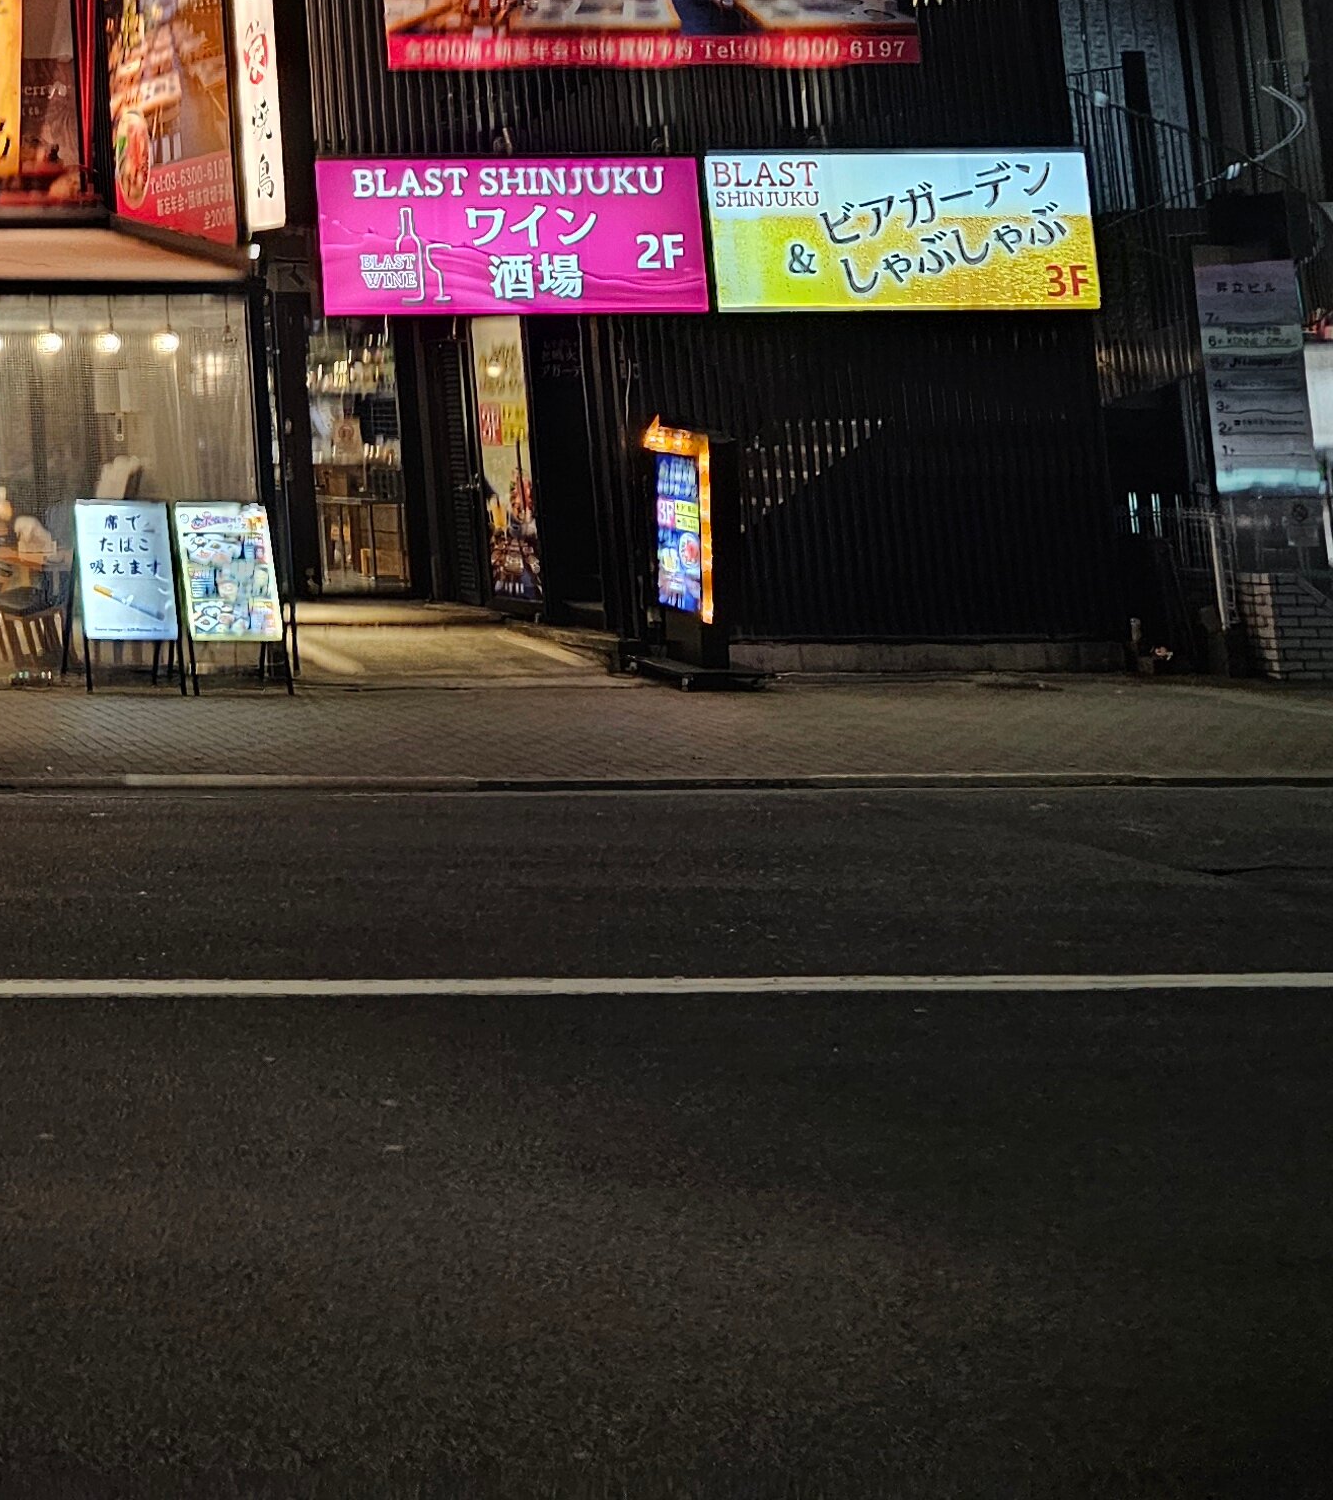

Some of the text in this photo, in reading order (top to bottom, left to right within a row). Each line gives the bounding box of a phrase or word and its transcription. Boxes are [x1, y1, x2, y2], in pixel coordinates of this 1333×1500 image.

[251, 96, 275, 199] 焼鳥
[352, 167, 665, 198] BLAST SHINJUKU
[712, 161, 818, 188] BLAST
[715, 190, 820, 208] SHINJUKU
[820, 159, 1051, 246] ビアガーデン
[465, 205, 597, 248] ワイン
[360, 254, 416, 270] BLAST
[636, 234, 685, 269] 2F
[788, 243, 817, 275] &
[839, 201, 1068, 294] しゃぶしゃぶ
[361, 272, 418, 289] WINE
[488, 254, 585, 300] 酒場
[1045, 263, 1090, 297] 3F
[104, 514, 141, 531] 席で
[99, 536, 149, 552] たばこ
[89, 559, 161, 576] 吸えます
